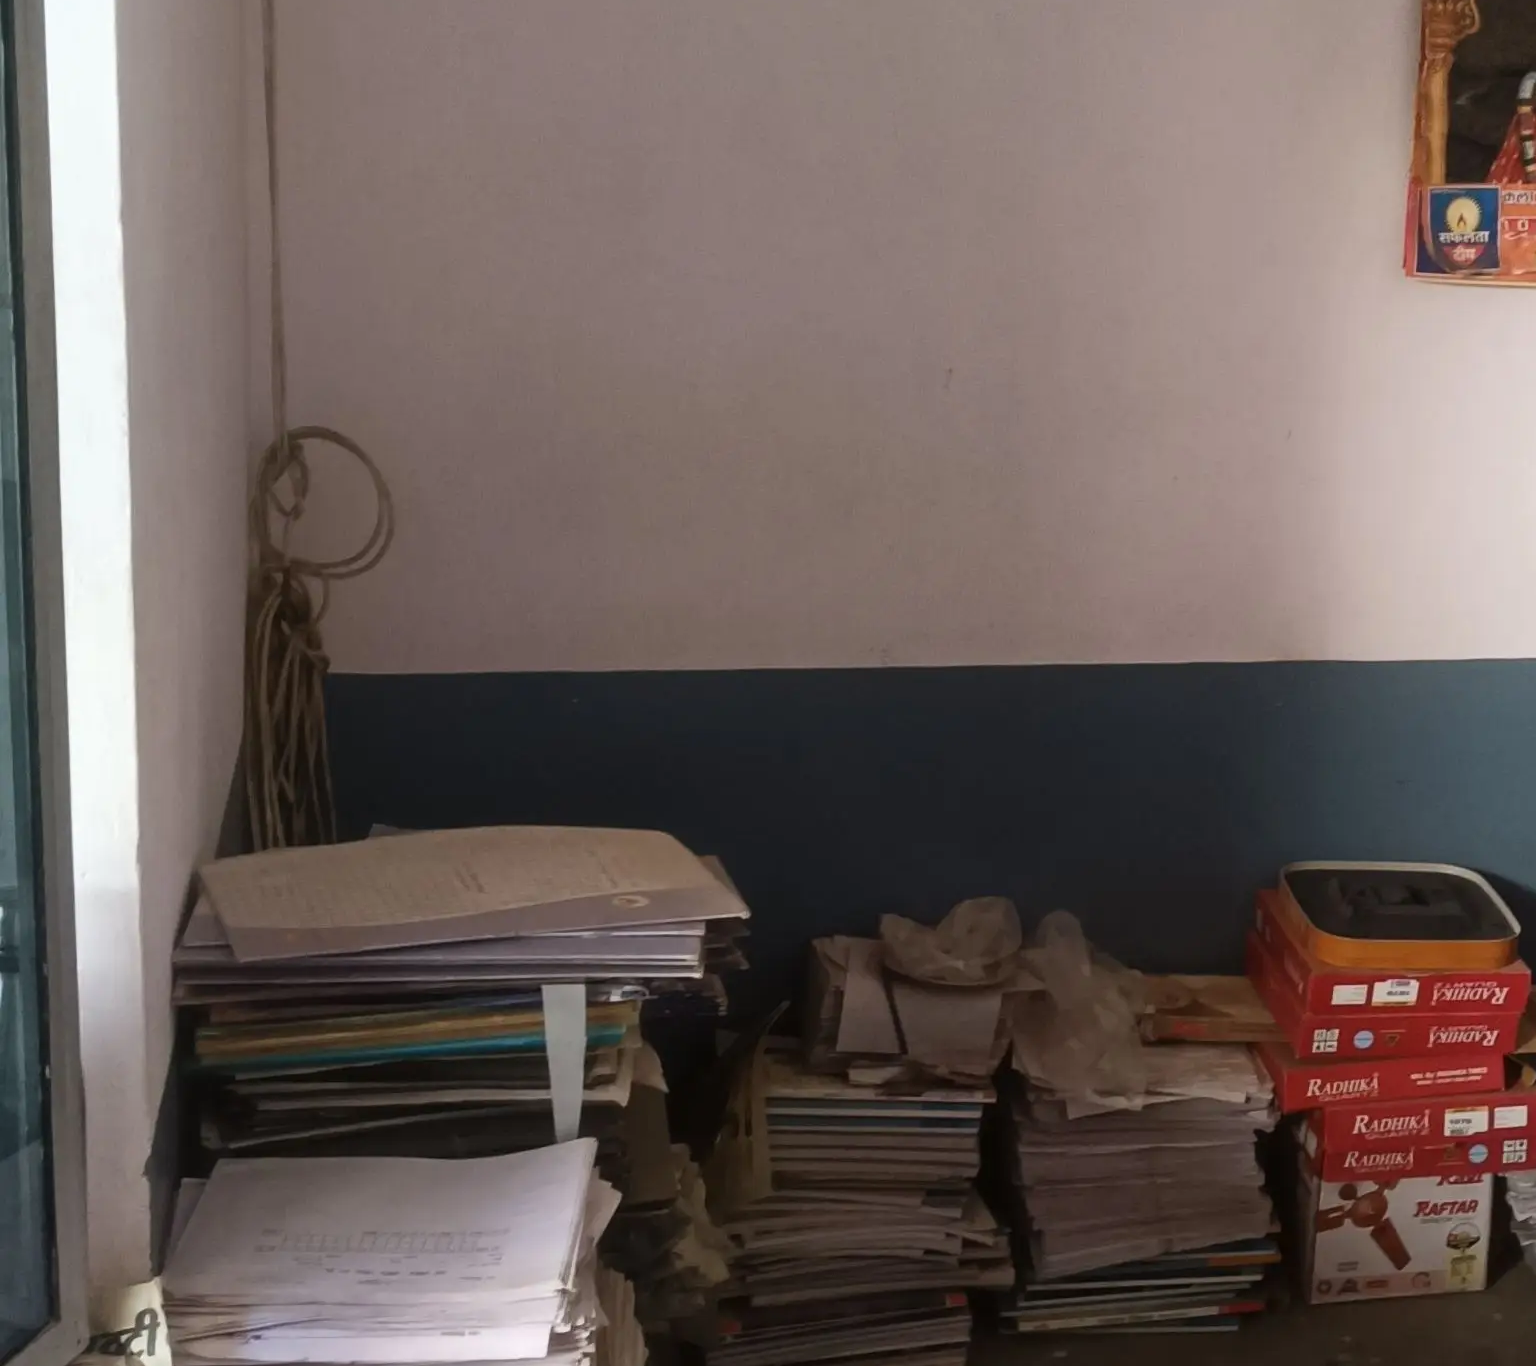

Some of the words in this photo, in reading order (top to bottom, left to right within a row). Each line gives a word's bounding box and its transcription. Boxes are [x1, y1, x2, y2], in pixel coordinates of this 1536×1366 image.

[1438, 230, 1490, 246] सफलता
[1431, 983, 1510, 1006] RADHIKA
[1427, 1029, 1499, 1048] RADHIKA
[1305, 1072, 1381, 1097] RADHIKA
[1352, 1109, 1431, 1135] RADHIKA
[1344, 1146, 1415, 1169] RADHIKA
[1413, 1199, 1480, 1218] RAFTAR
